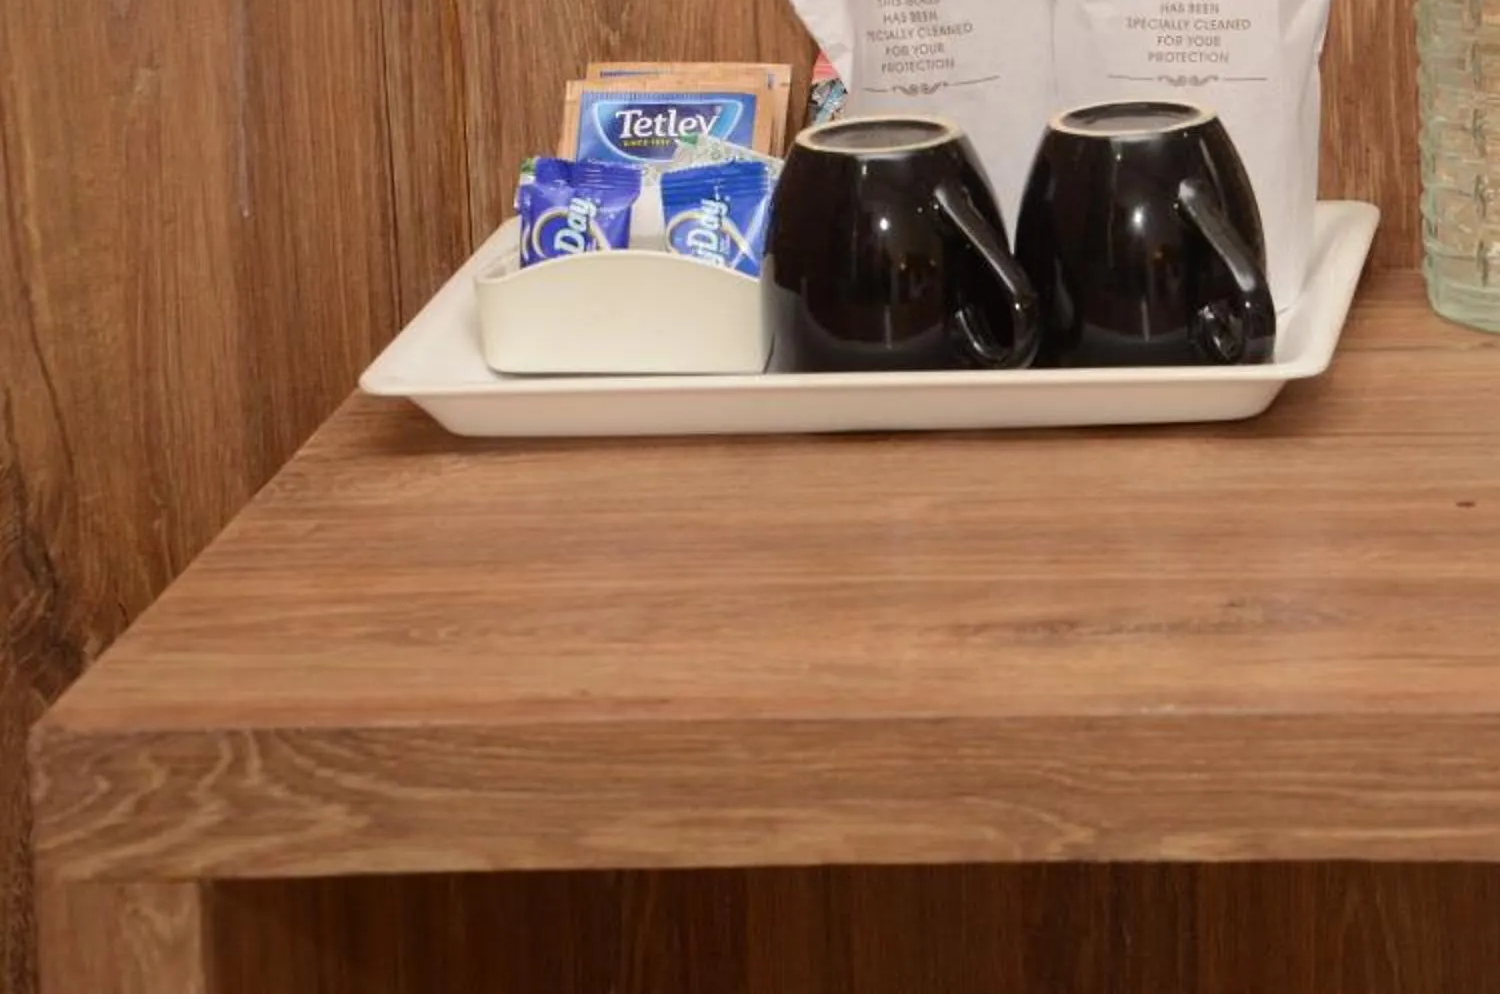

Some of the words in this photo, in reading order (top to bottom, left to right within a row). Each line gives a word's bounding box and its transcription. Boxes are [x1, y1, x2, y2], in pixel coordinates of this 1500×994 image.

[1159, 3, 1185, 14] HAS
[1188, 3, 1220, 14] BEEN
[883, 11, 907, 24] HAS
[909, 10, 938, 23] BEEN
[917, 22, 974, 39] CLEANED
[1127, 18, 1190, 31] SPECIALLY
[1193, 18, 1252, 31] CLEANED
[1156, 35, 1182, 47] FOR
[1187, 35, 1221, 47] YOUR
[885, 45, 909, 58] FOR
[912, 43, 945, 56] YOUR
[1148, 51, 1230, 64] PROTECTION
[881, 57, 955, 74] PROTECTION
[615, 107, 720, 138] Tetley
